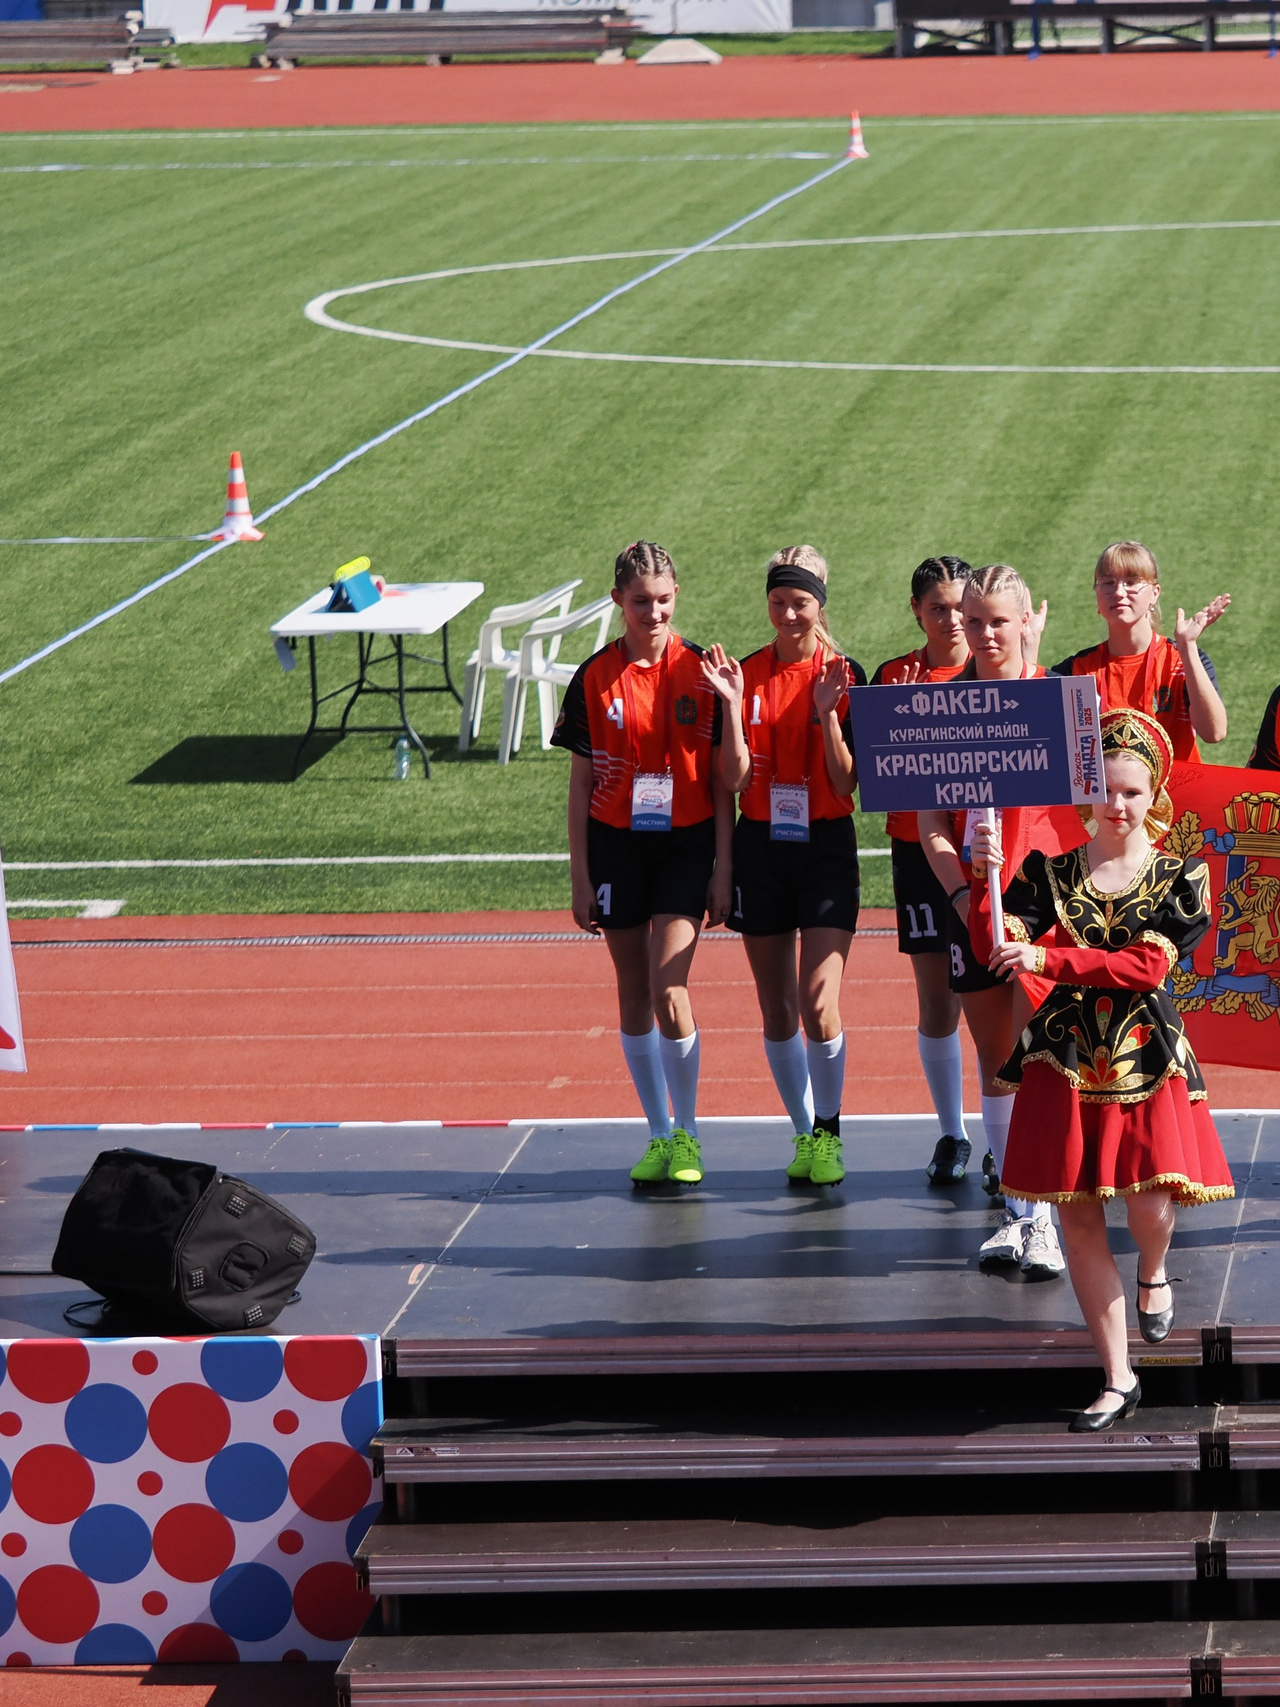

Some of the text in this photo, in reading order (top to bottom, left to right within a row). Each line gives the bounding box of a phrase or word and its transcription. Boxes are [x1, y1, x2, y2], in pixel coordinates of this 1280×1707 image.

[605, 697, 624, 730] 4
[750, 694, 761, 725] 1
[893, 687, 1019, 717] «ФАКЕЛ»
[1075, 688, 1085, 727] КРАСНОЯРСК
[1084, 707, 1093, 726] 2025
[889, 722, 1029, 742] КУРАГИНСКИЙ РАЙОН
[875, 743, 1049, 777] КРАСНОЯРСКИЙ
[935, 776, 994, 805] КРАЙ
[635, 819, 667, 827] УЧАСТНИК
[775, 829, 805, 837] УЧАСТНИК
[596, 883, 612, 916] 4
[905, 902, 938, 939] 11
